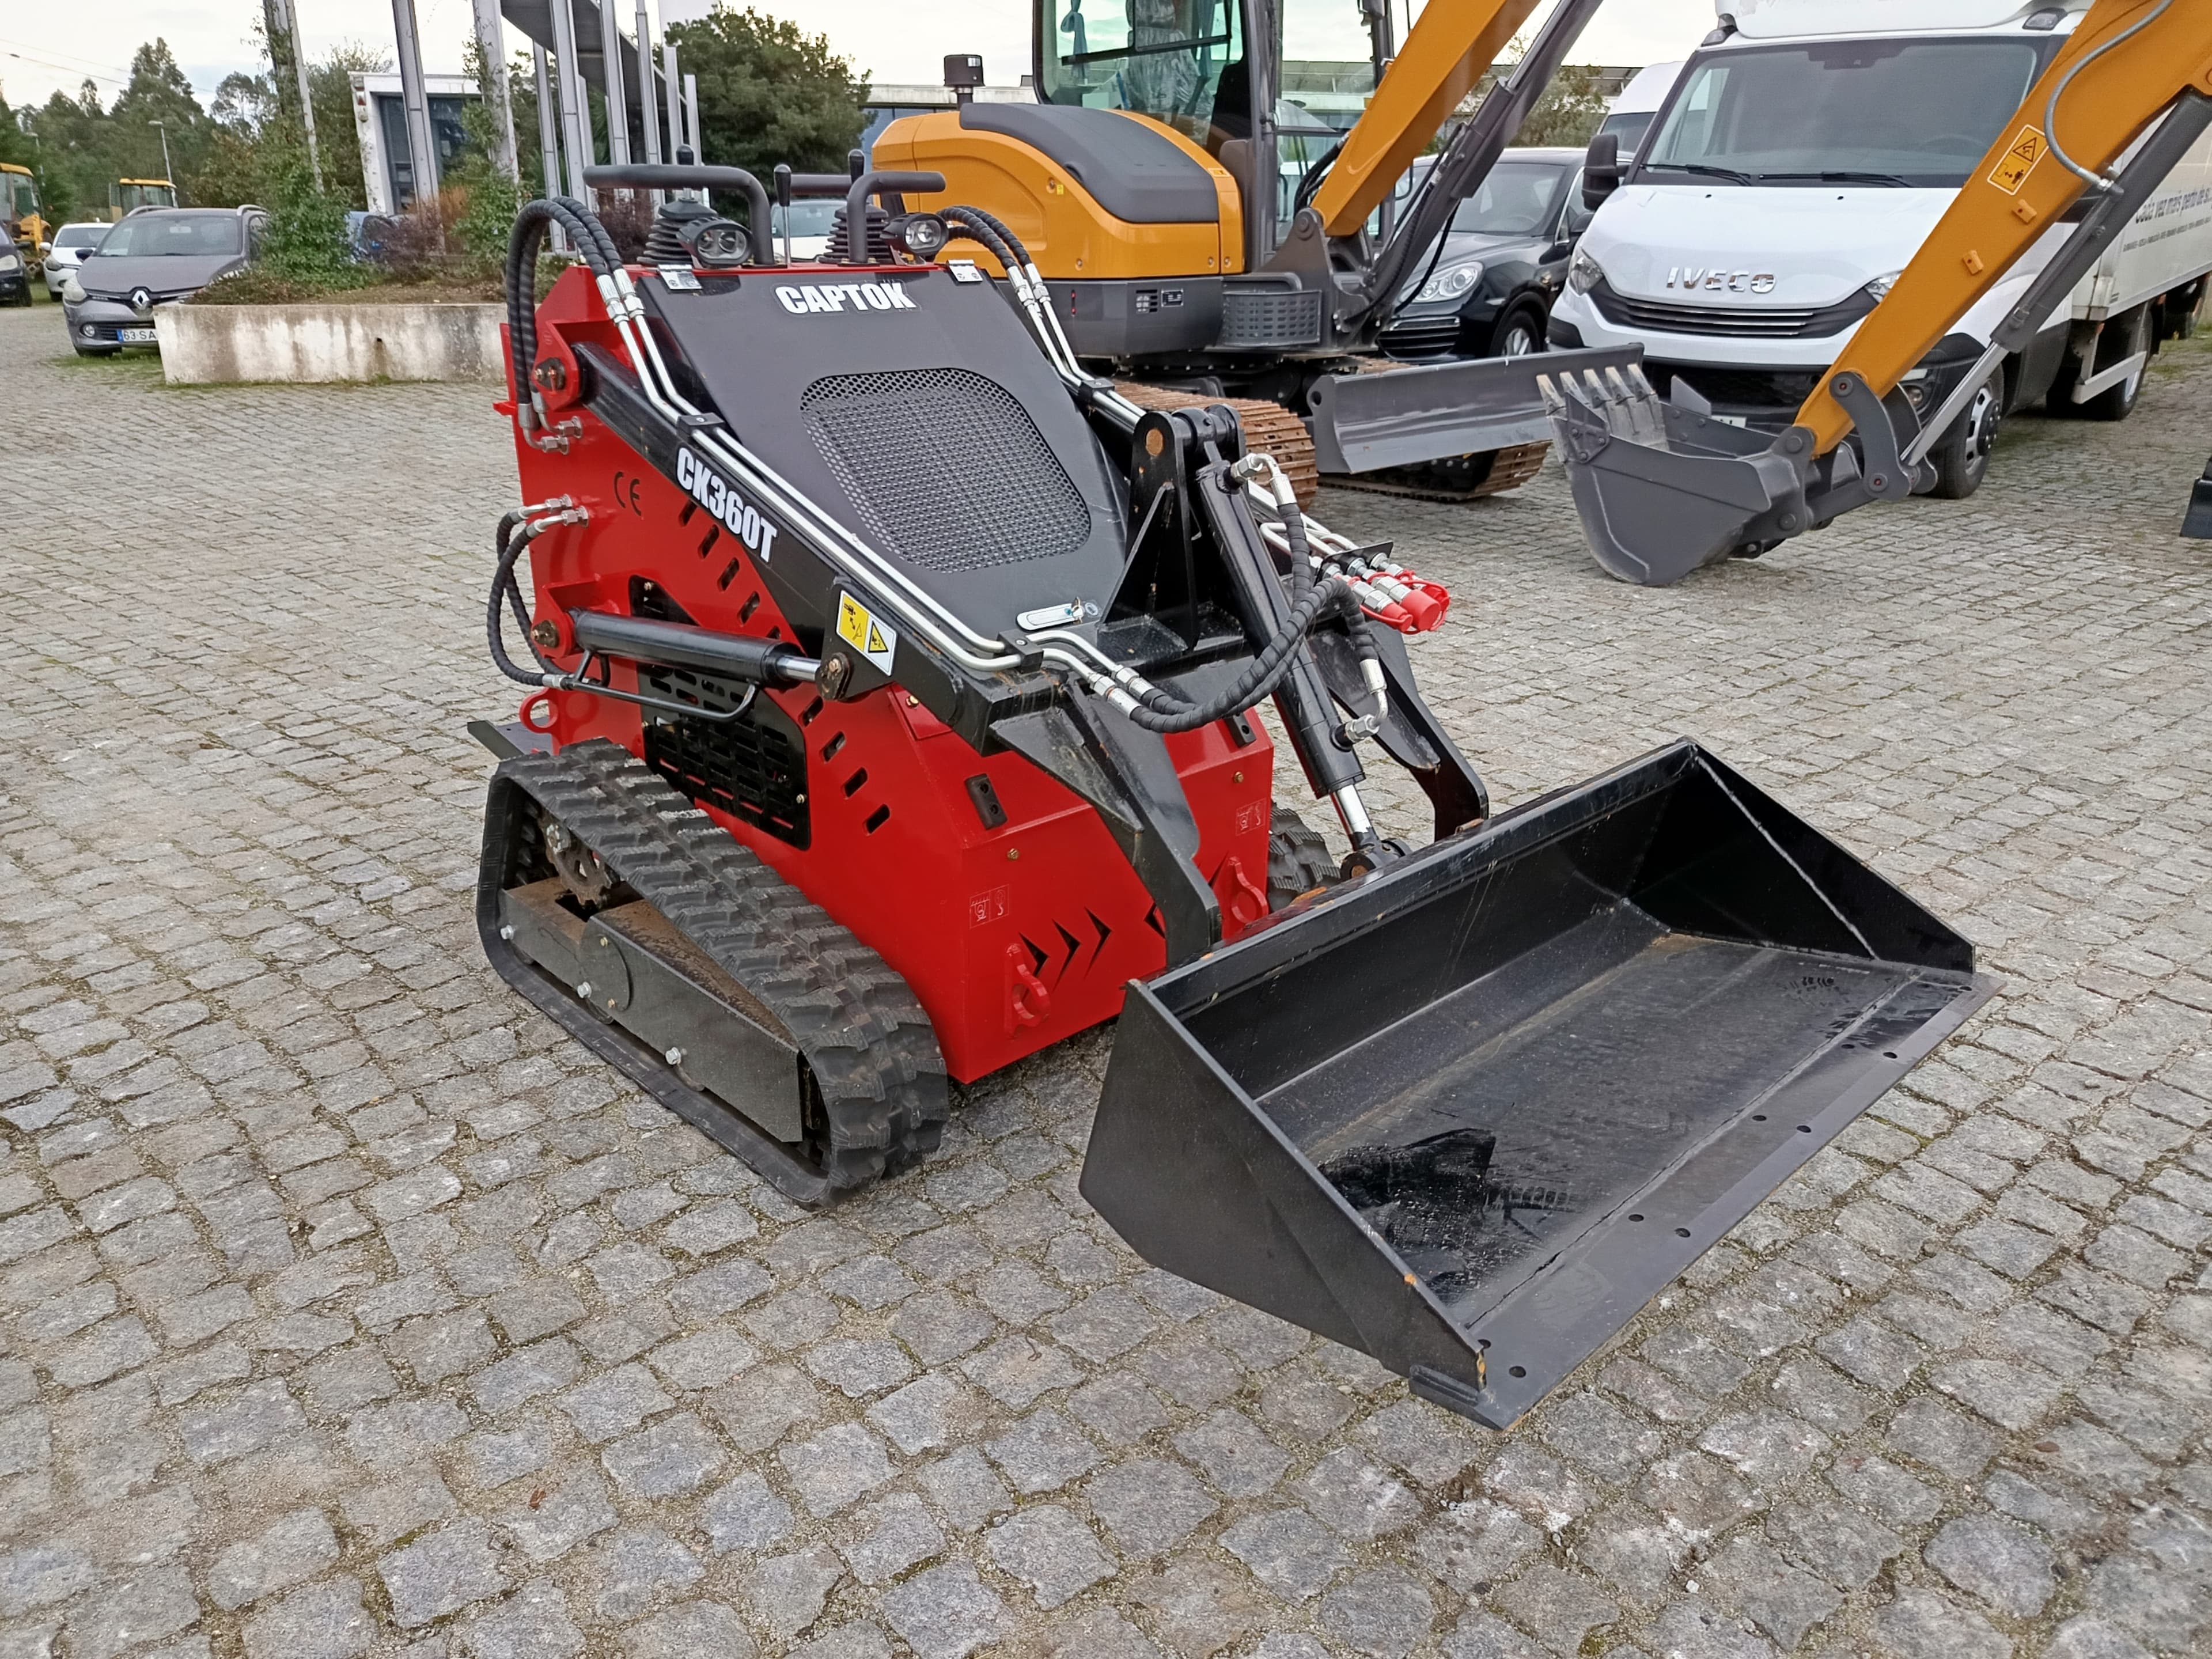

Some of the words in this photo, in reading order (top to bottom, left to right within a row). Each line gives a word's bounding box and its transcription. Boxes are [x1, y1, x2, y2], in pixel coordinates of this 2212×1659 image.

[775, 283, 917, 314] CAPTOK
[1666, 267, 1777, 294] IVECO
[614, 471, 642, 517] CE
[677, 447, 777, 563] CK360T
